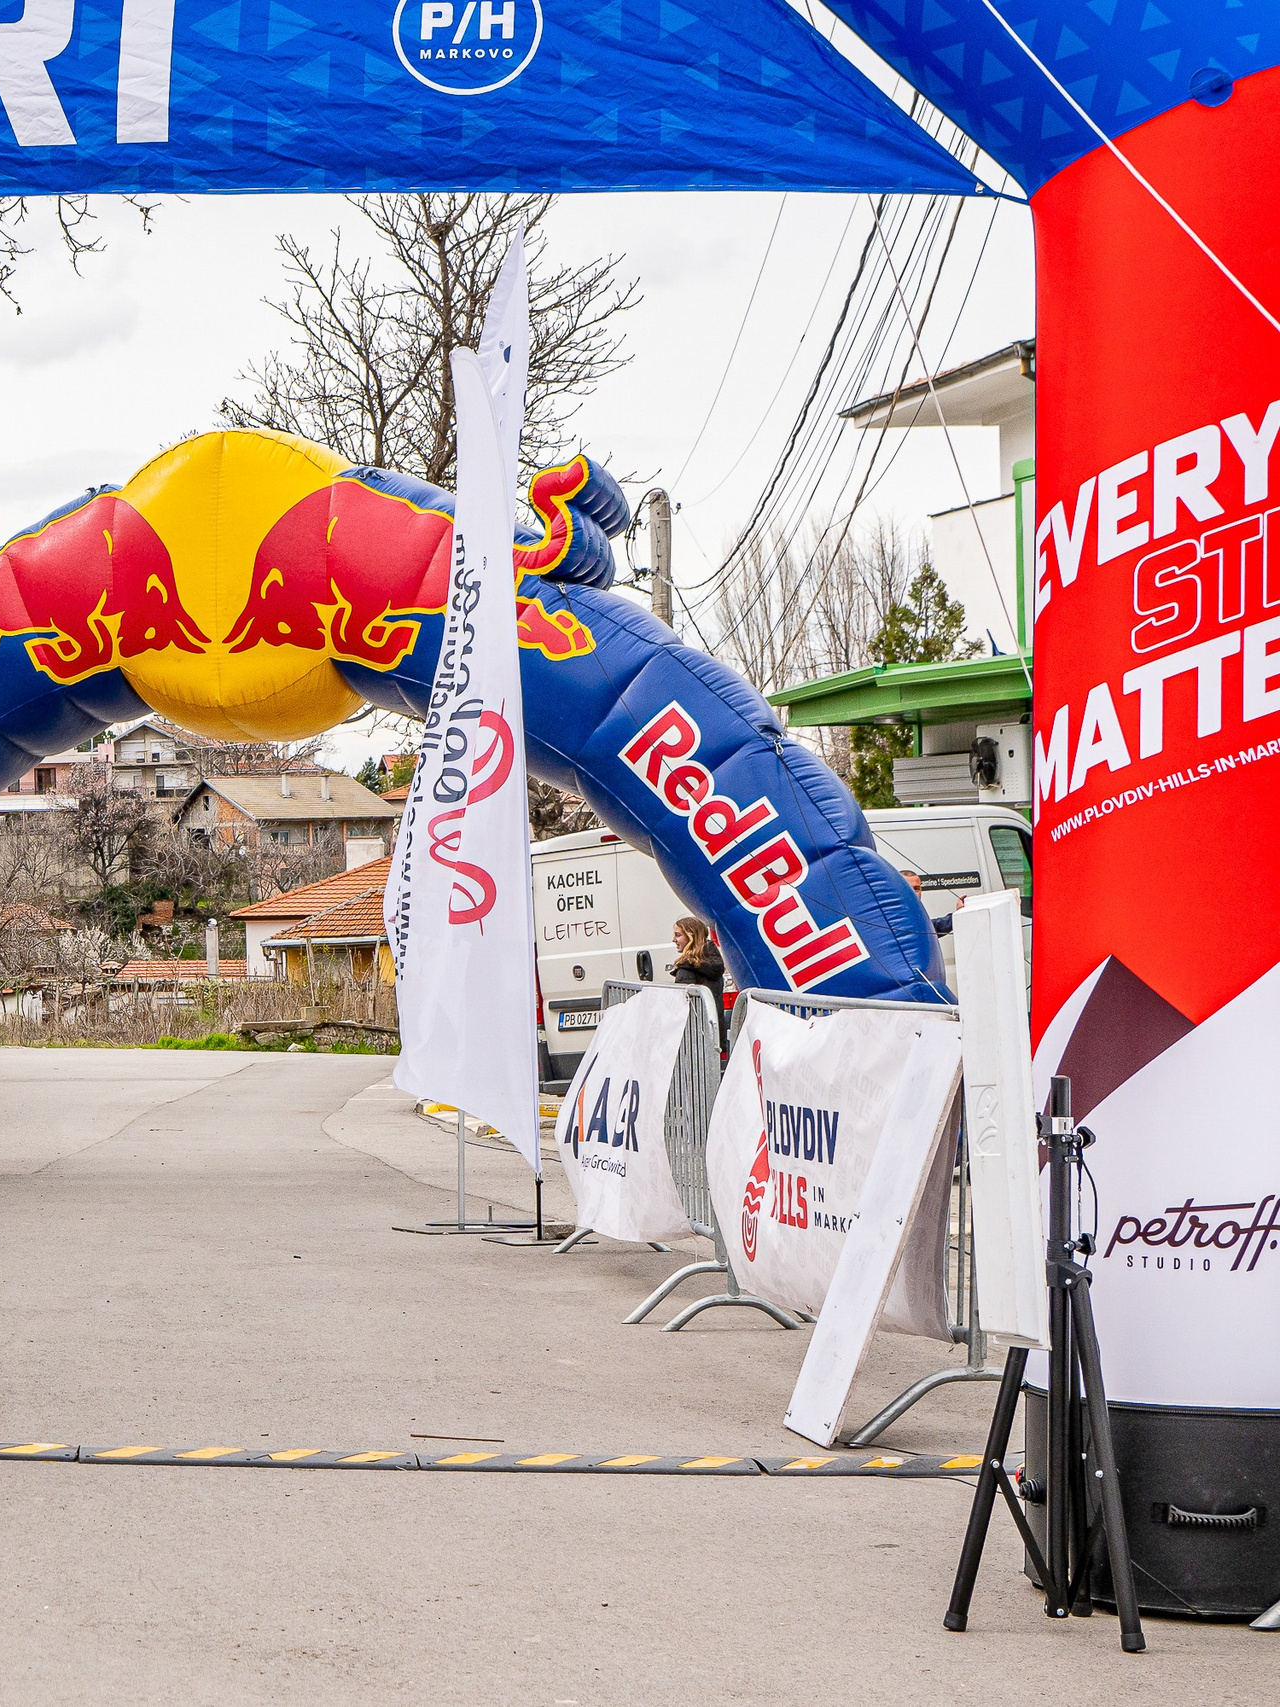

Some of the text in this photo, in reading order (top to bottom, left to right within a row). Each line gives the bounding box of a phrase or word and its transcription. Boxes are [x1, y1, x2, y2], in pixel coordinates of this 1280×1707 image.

[420, 1, 516, 44] P/H
[420, 48, 514, 60] MARKOVO
[1034, 399, 1280, 624] EVERY
[621, 703, 868, 990] Red Bull
[548, 870, 602, 890] KACHEL
[557, 894, 594, 912] ÖFEN
[544, 921, 610, 942] LEITER
[577, 1013, 597, 1025] 0271
[766, 1100, 840, 1166] PLOVDIV
[814, 1186, 825, 1204] IN
[1126, 1254, 1212, 1272] STUDIO
